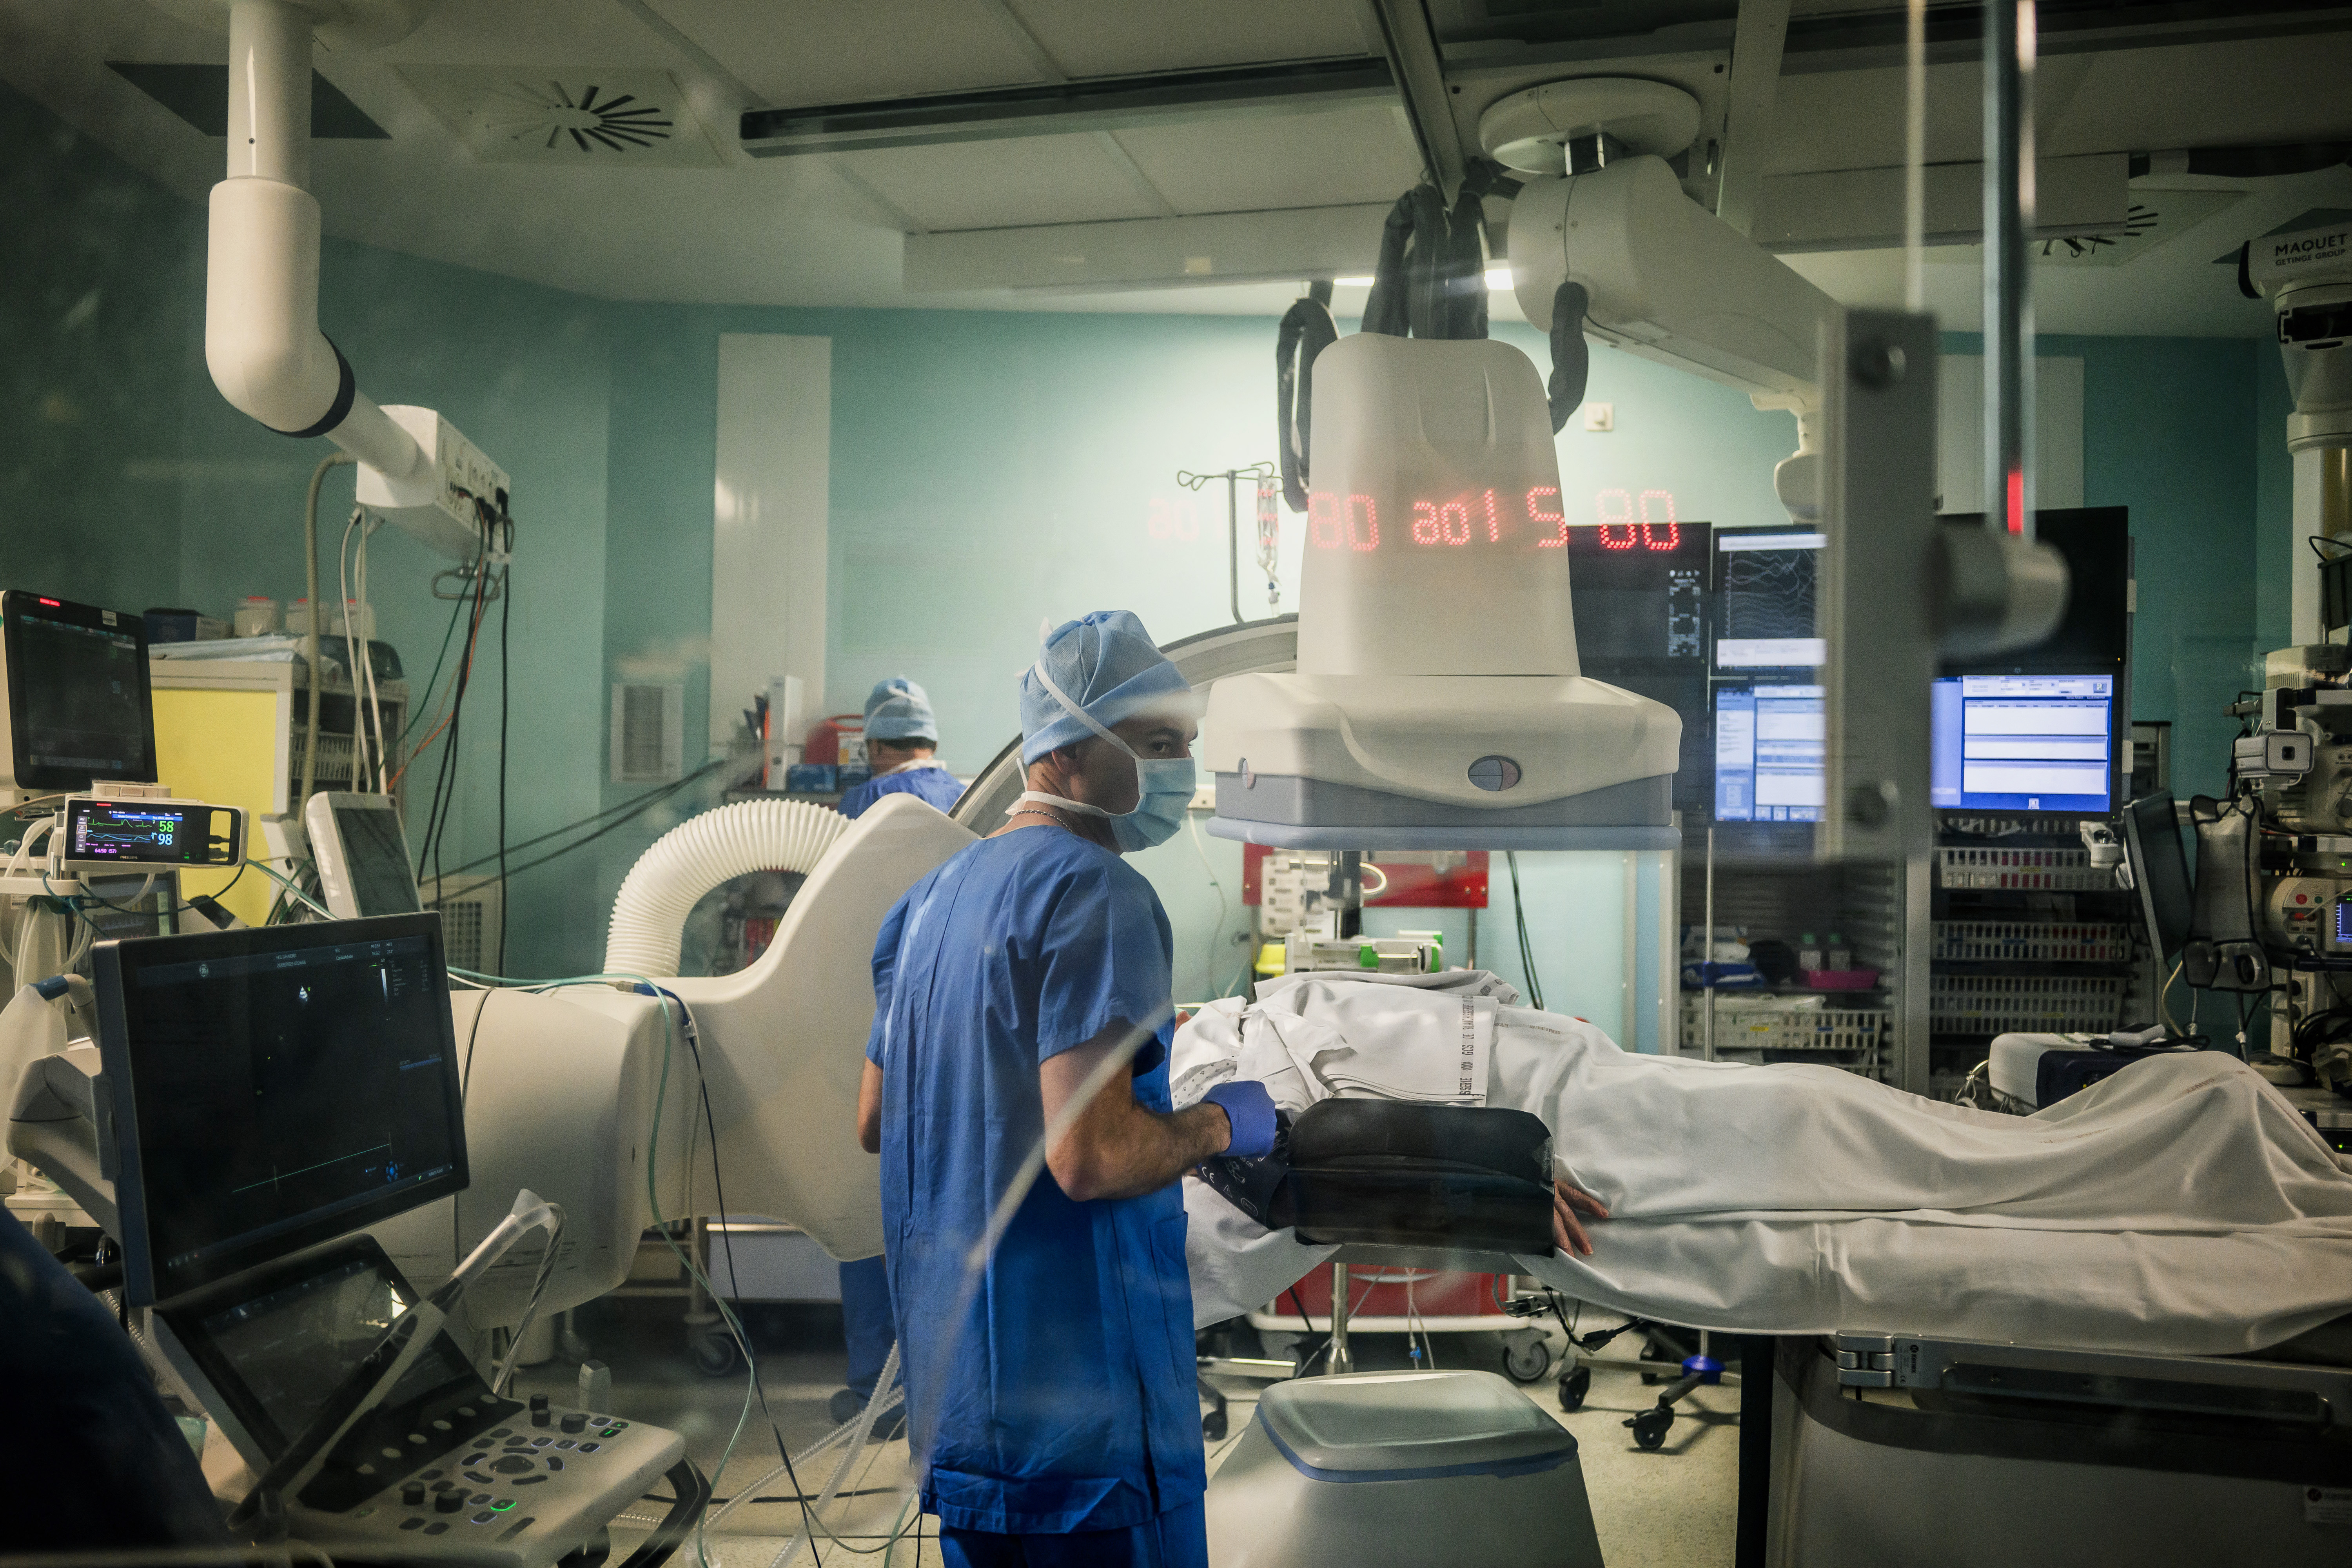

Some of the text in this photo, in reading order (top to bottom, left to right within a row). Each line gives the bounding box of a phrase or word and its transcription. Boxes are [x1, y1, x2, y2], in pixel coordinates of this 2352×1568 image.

[2276, 234, 2348, 256] MAQUET
[2275, 249, 2346, 266] GETINGE GROUP
[159, 821, 174, 832] 58
[158, 834, 173, 845] 98
[1462, 1045, 1474, 1055] GCS
